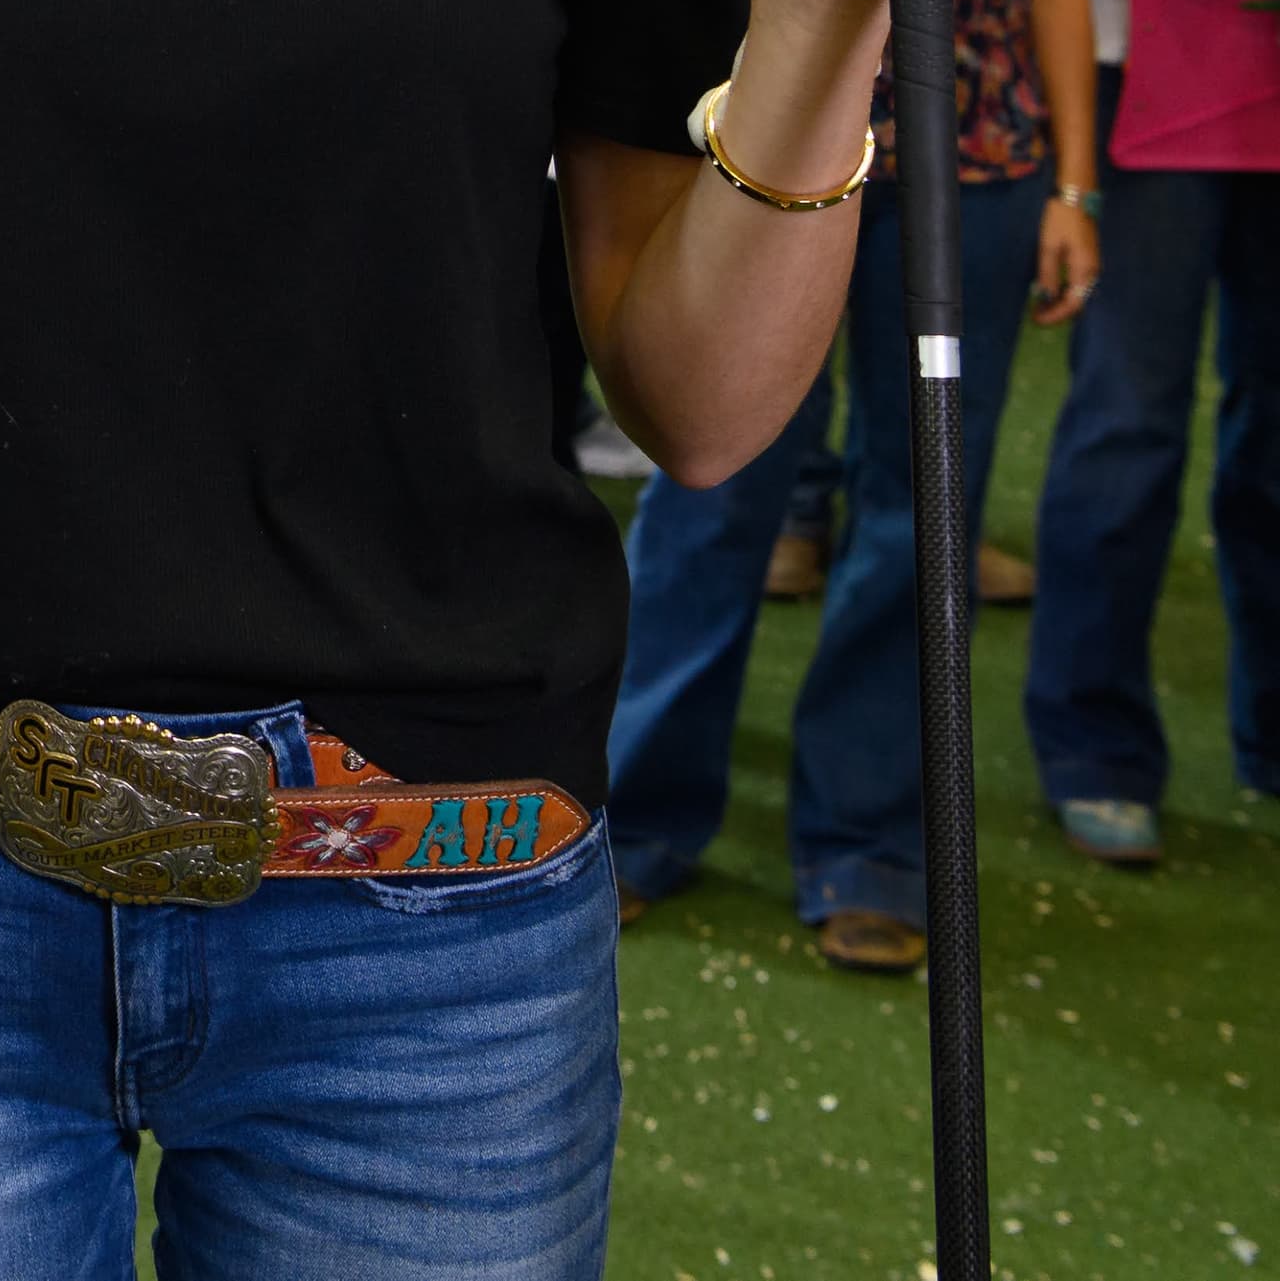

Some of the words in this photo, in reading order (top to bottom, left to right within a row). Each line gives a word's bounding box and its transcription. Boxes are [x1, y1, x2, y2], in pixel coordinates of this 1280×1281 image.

[83, 734, 252, 820] CHAMPION
[14, 841, 75, 867] YOUTH
[83, 831, 177, 863] MARKET
[182, 824, 249, 842] STEER
[403, 794, 545, 868] AH
